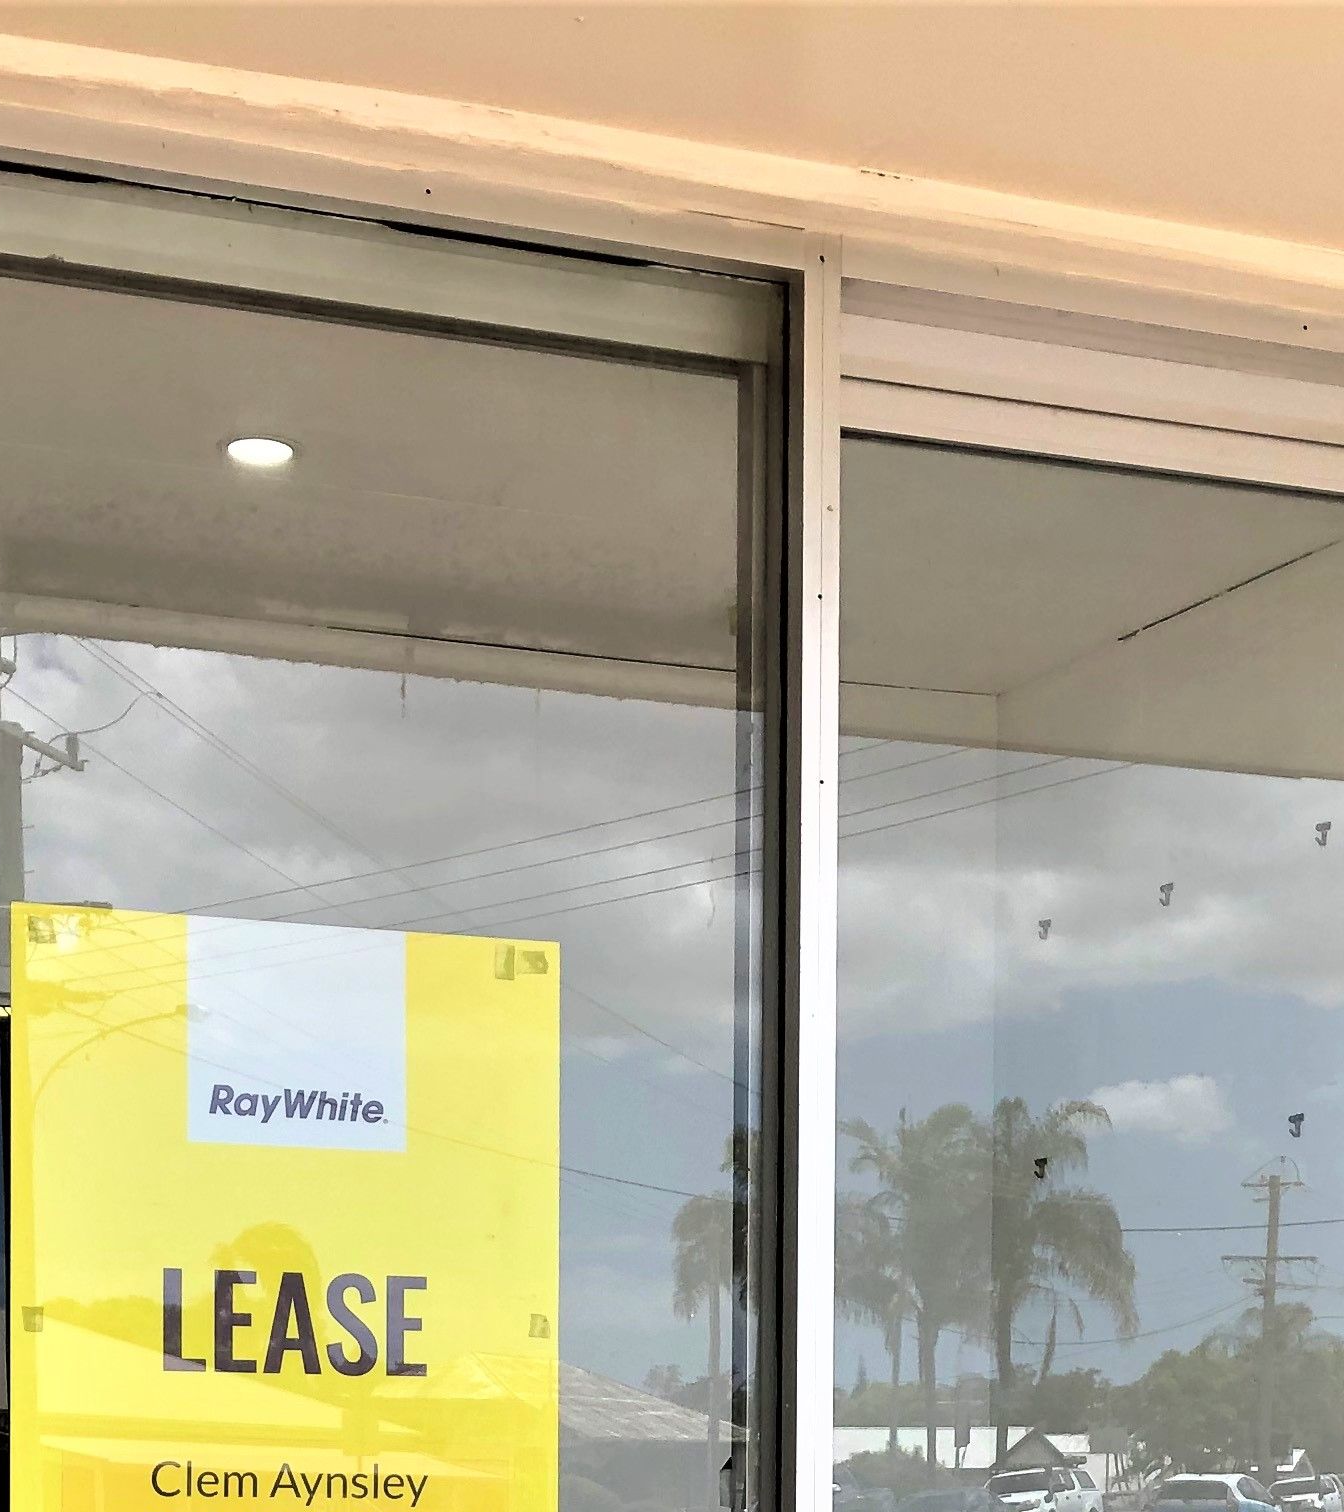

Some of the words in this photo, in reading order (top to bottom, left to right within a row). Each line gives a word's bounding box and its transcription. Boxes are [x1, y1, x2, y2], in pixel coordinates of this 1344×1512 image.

[162, 1267, 428, 1377] LEASE
[151, 1461, 258, 1498] Clem
[269, 1462, 429, 1508] Aynsley
